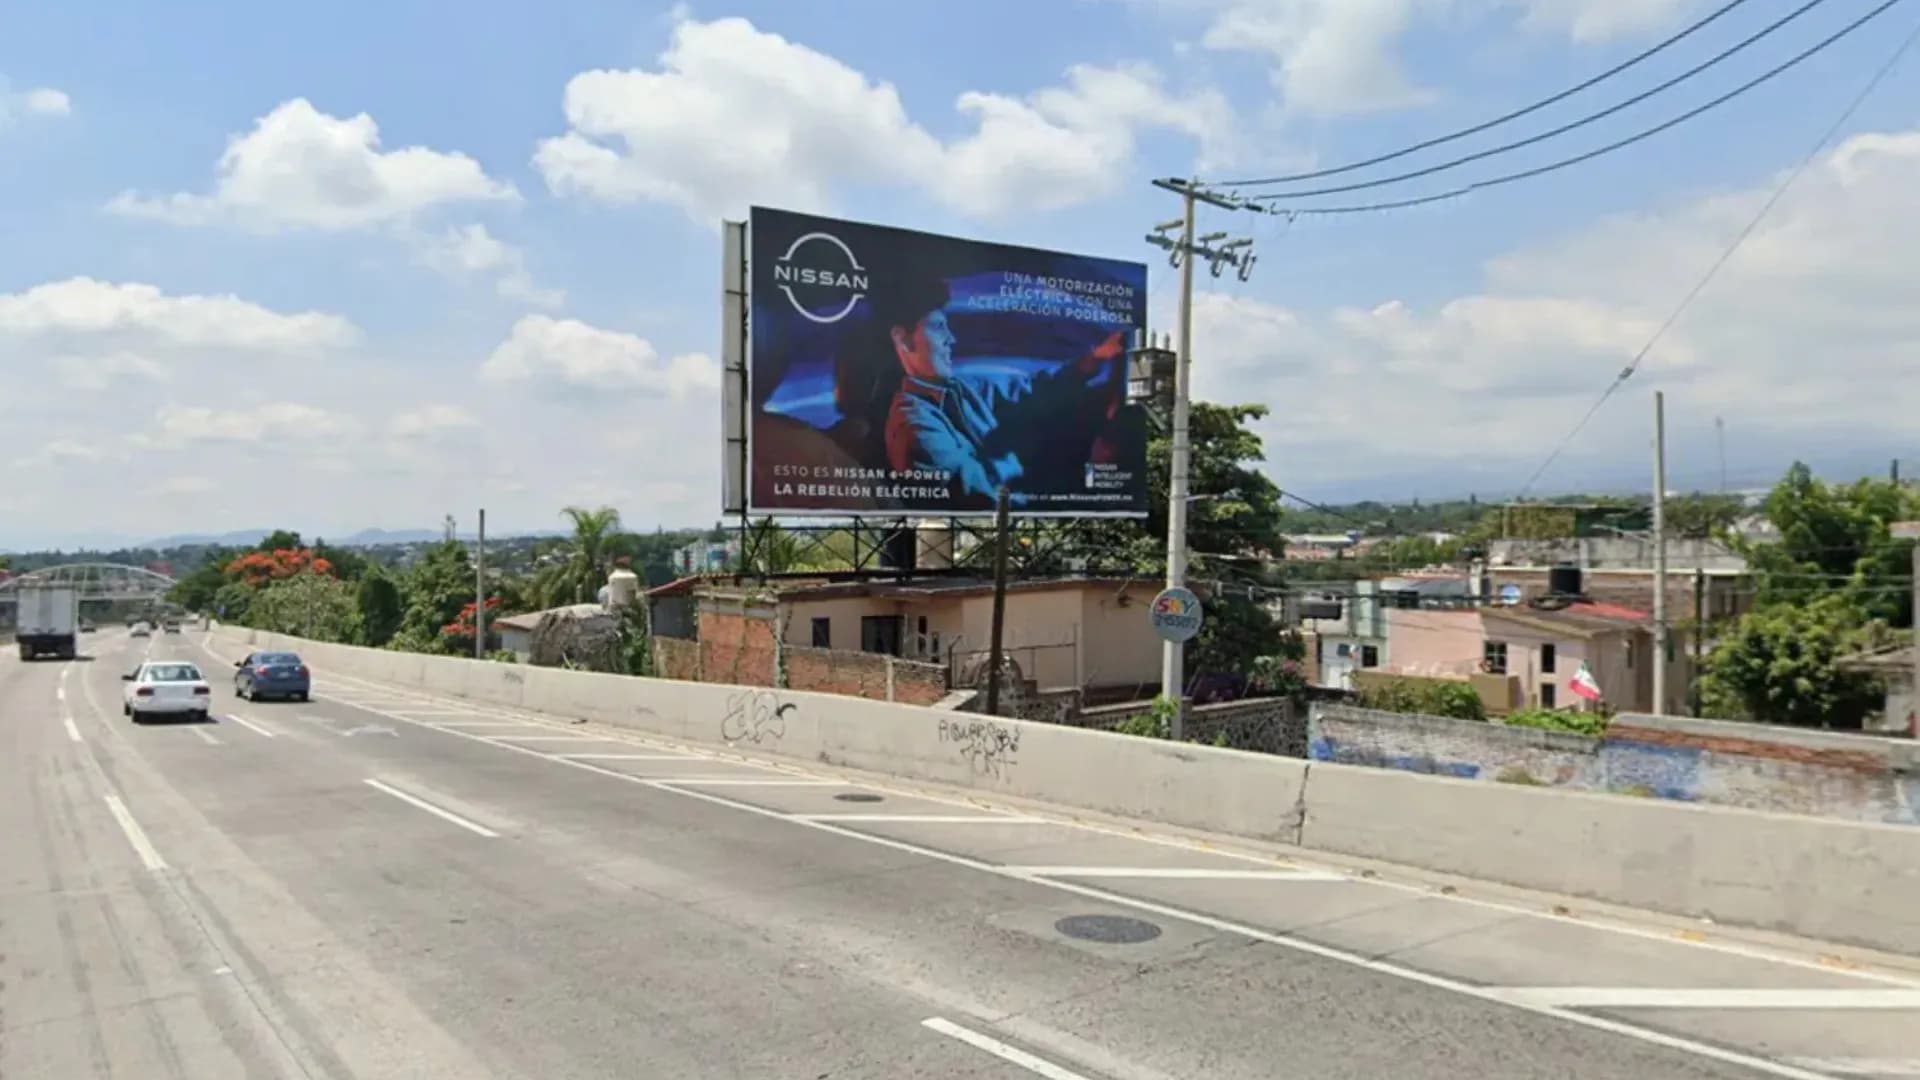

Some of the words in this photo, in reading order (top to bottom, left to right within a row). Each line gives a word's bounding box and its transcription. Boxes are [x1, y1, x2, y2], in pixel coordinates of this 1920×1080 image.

[774, 265, 868, 290] NISSAN
[1004, 272, 1032, 285] UNA
[1036, 275, 1134, 297] MOTORIZACIÓN
[967, 295, 1062, 317] ACELERACIÓN
[1065, 308, 1133, 324] PODEROSA
[1000, 284, 1073, 303] ELÉCTRICA
[1077, 294, 1104, 307] CON
[1108, 298, 1133, 310] UNA
[774, 464, 808, 477] ESTO
[814, 466, 829, 478] ES
[833, 467, 885, 479] NISSAN
[774, 483, 793, 495] LA
[797, 483, 871, 498] REBELIÓN
[876, 485, 951, 498] ELÉCTRICA
